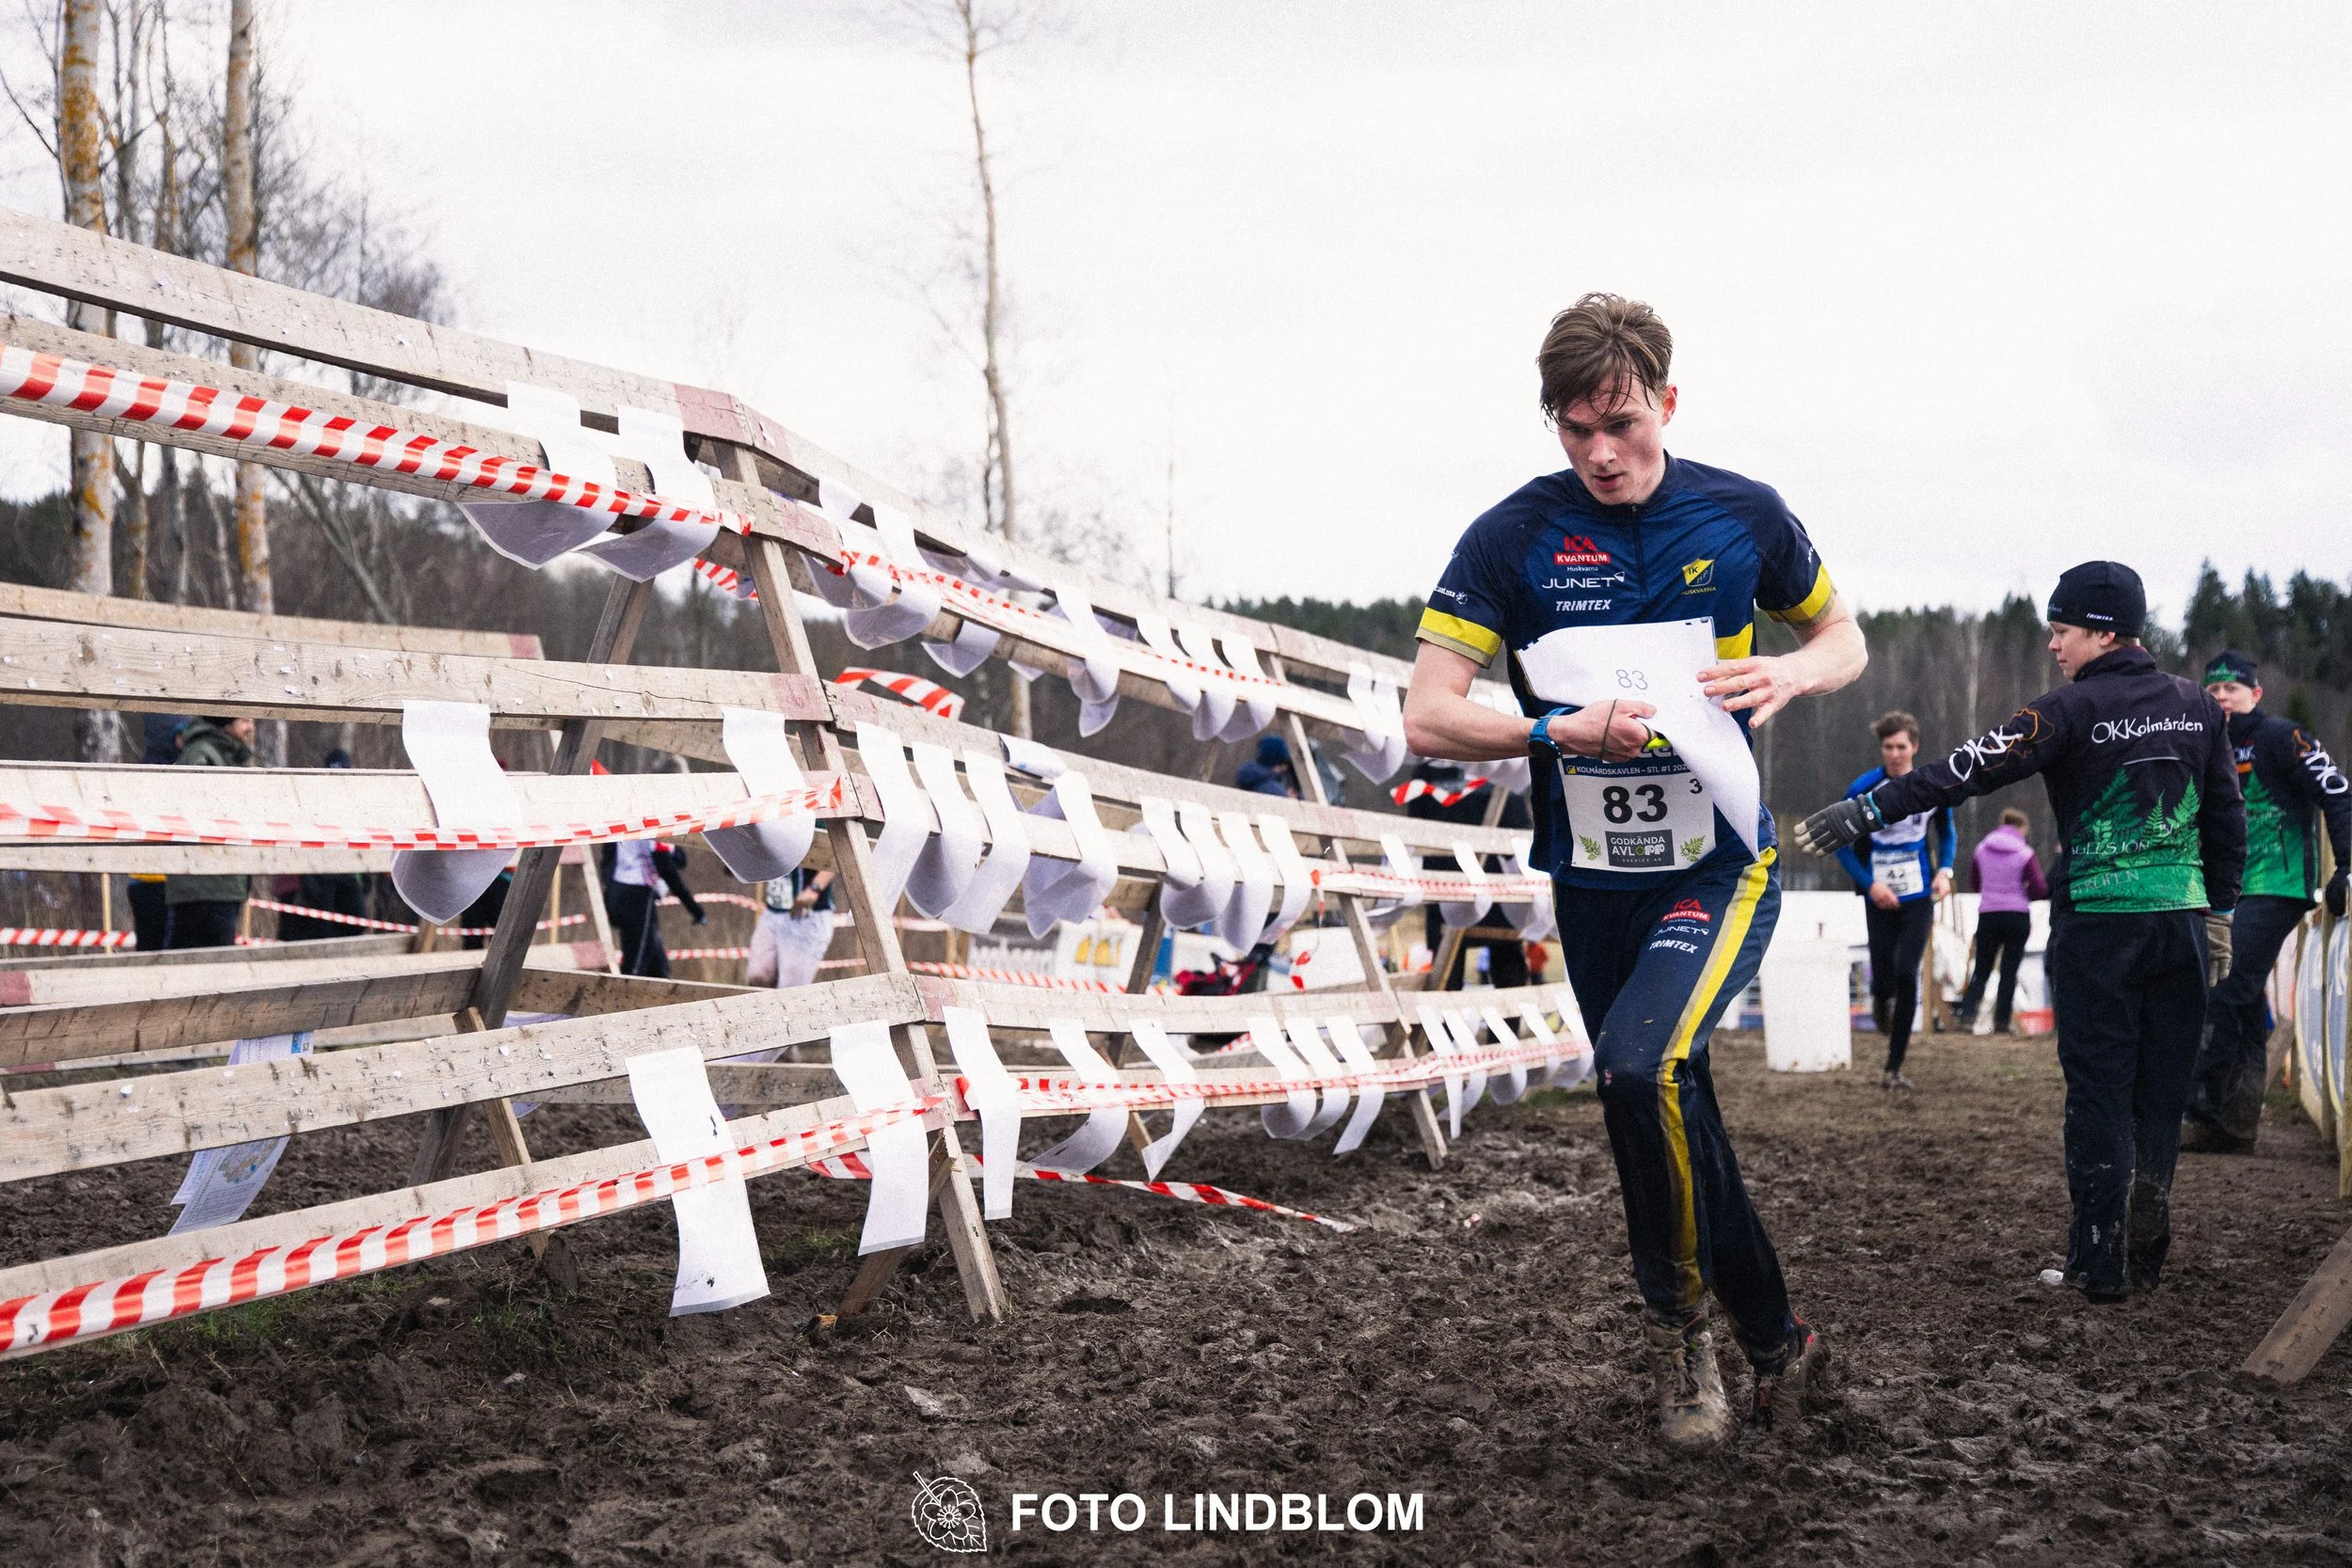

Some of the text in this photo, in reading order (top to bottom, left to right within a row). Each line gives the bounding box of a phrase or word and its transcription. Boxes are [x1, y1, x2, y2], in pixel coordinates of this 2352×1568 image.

[1565, 535, 1597, 551] ICA
[1557, 554, 1608, 562] KVANTUM
[1542, 577, 1615, 589] JUNET
[1556, 599, 1612, 611] TRIMTEX
[1615, 669, 1648, 690] 83
[1576, 765, 1641, 775] KOLMÅRDSKAVLEN
[1689, 778, 1703, 794] 3
[1602, 784, 1668, 824] 83
[1610, 835, 1665, 846] GODKÄNDA
[1673, 898, 1702, 912] ICA
[1662, 911, 1708, 921] KVANTUM
[1654, 926, 1702, 937] JUNET
[1649, 939, 1698, 955] TRIMTEX
